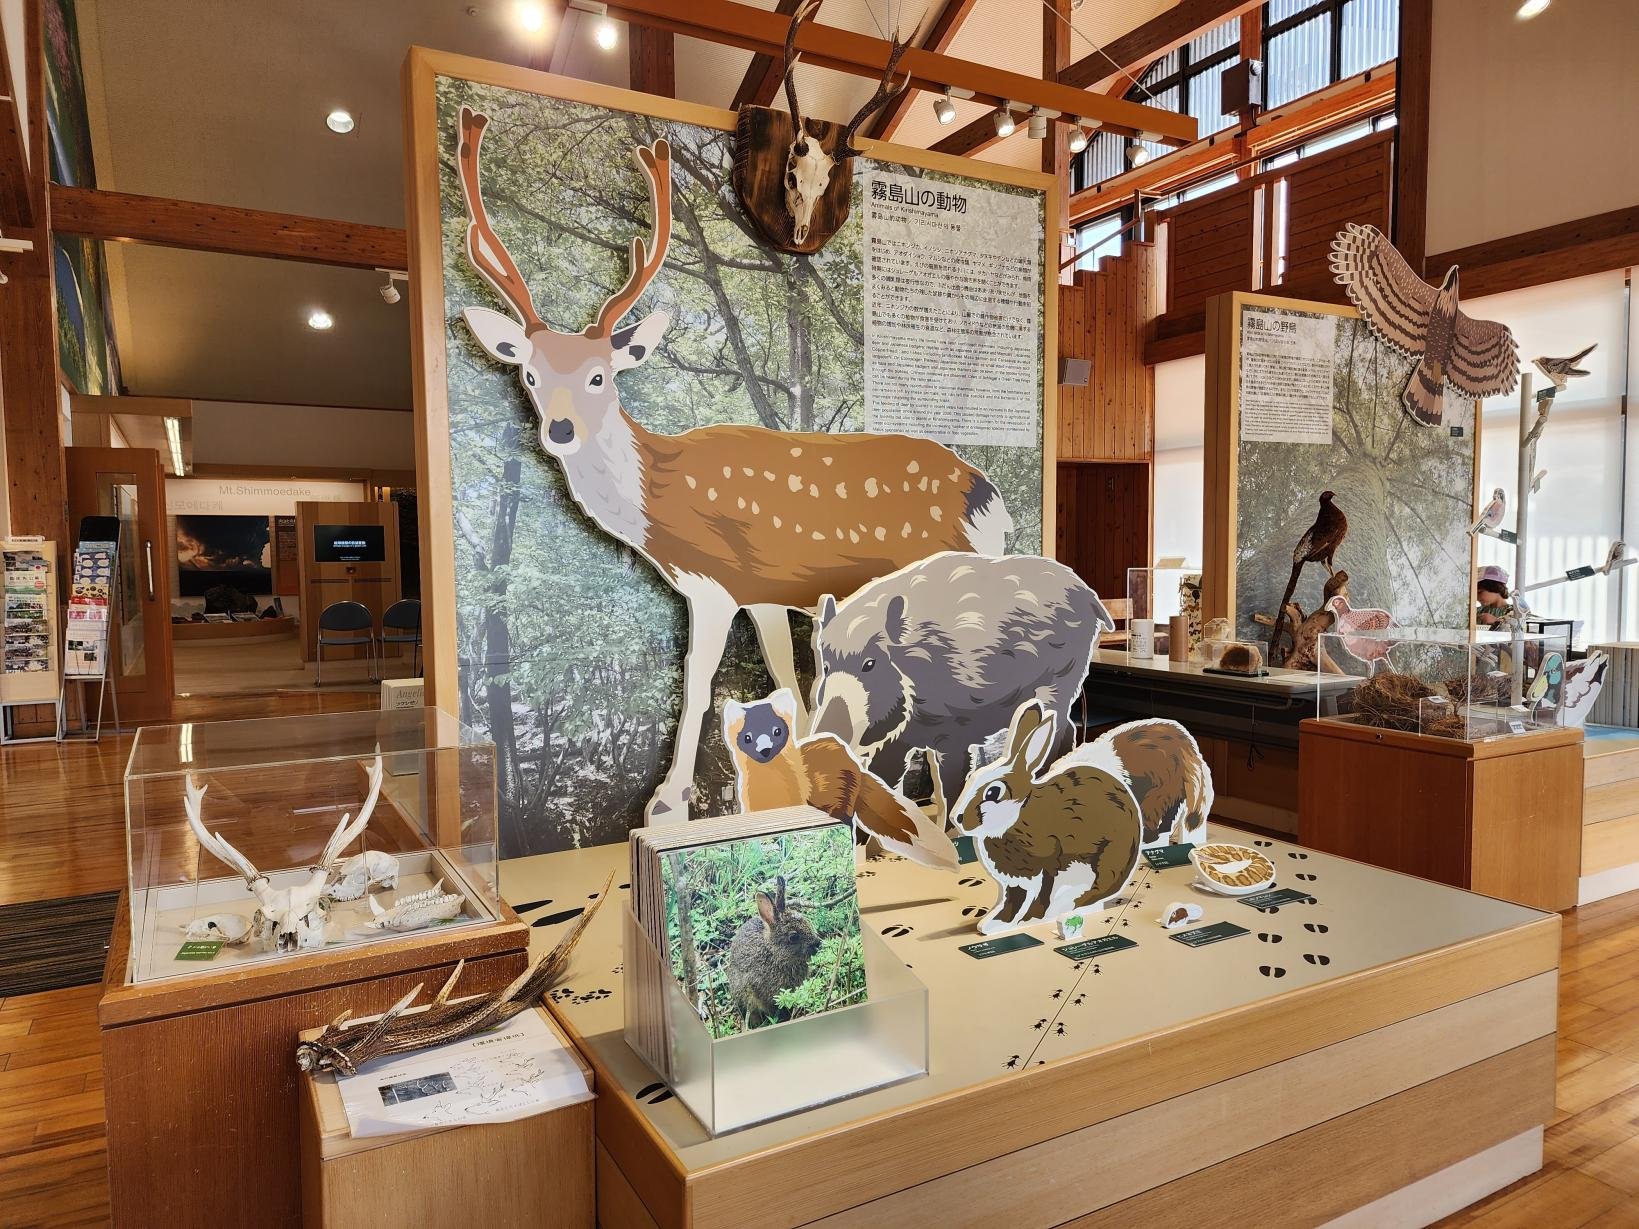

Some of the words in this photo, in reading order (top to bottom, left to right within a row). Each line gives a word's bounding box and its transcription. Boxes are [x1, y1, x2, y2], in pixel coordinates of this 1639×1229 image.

[871, 180, 967, 214] 霧島山の動物
[871, 202, 893, 211] Animals
[1247, 316, 1297, 335] 霧島山の野鳥
